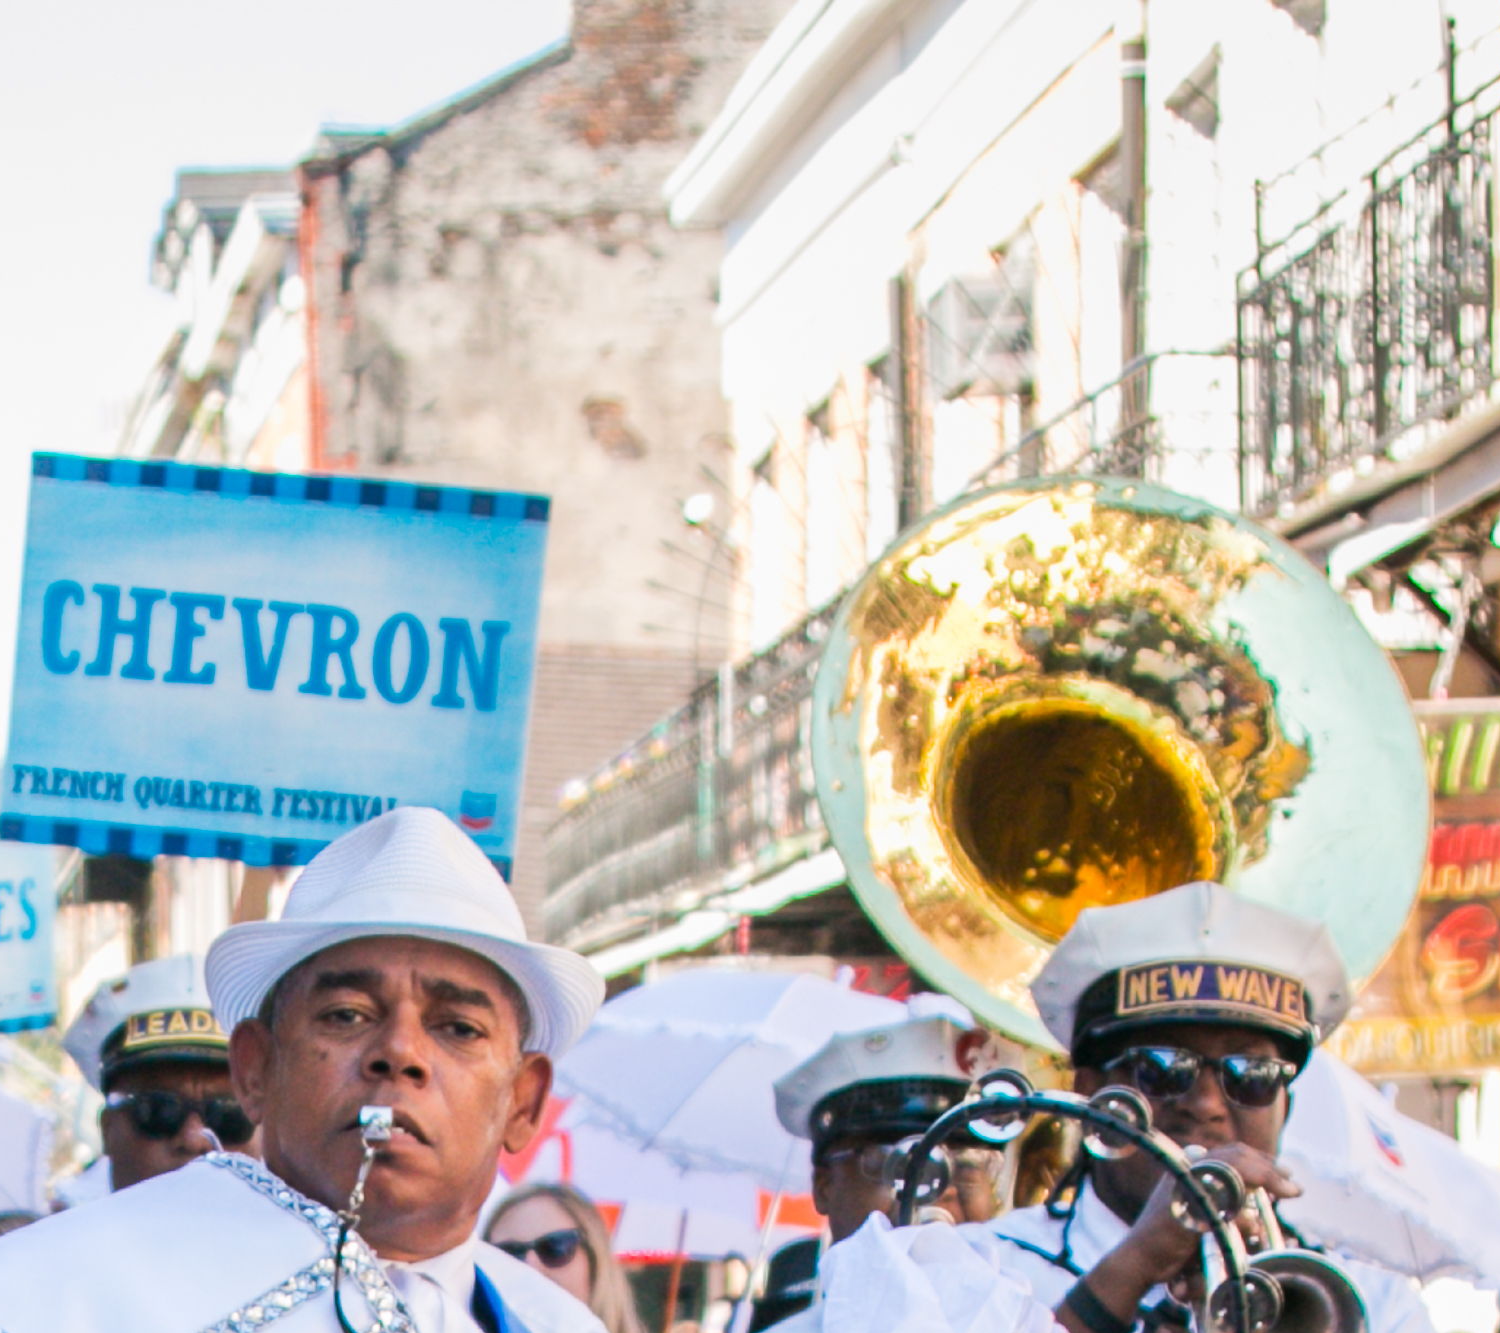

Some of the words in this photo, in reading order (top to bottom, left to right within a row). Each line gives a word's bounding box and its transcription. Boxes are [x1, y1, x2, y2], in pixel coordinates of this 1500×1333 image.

[40, 578, 512, 713] CHEVRON
[12, 763, 126, 803] FRENCH
[133, 775, 262, 816] QUARTER
[1128, 964, 1204, 1007] NEW
[1216, 965, 1300, 1018] WAVE
